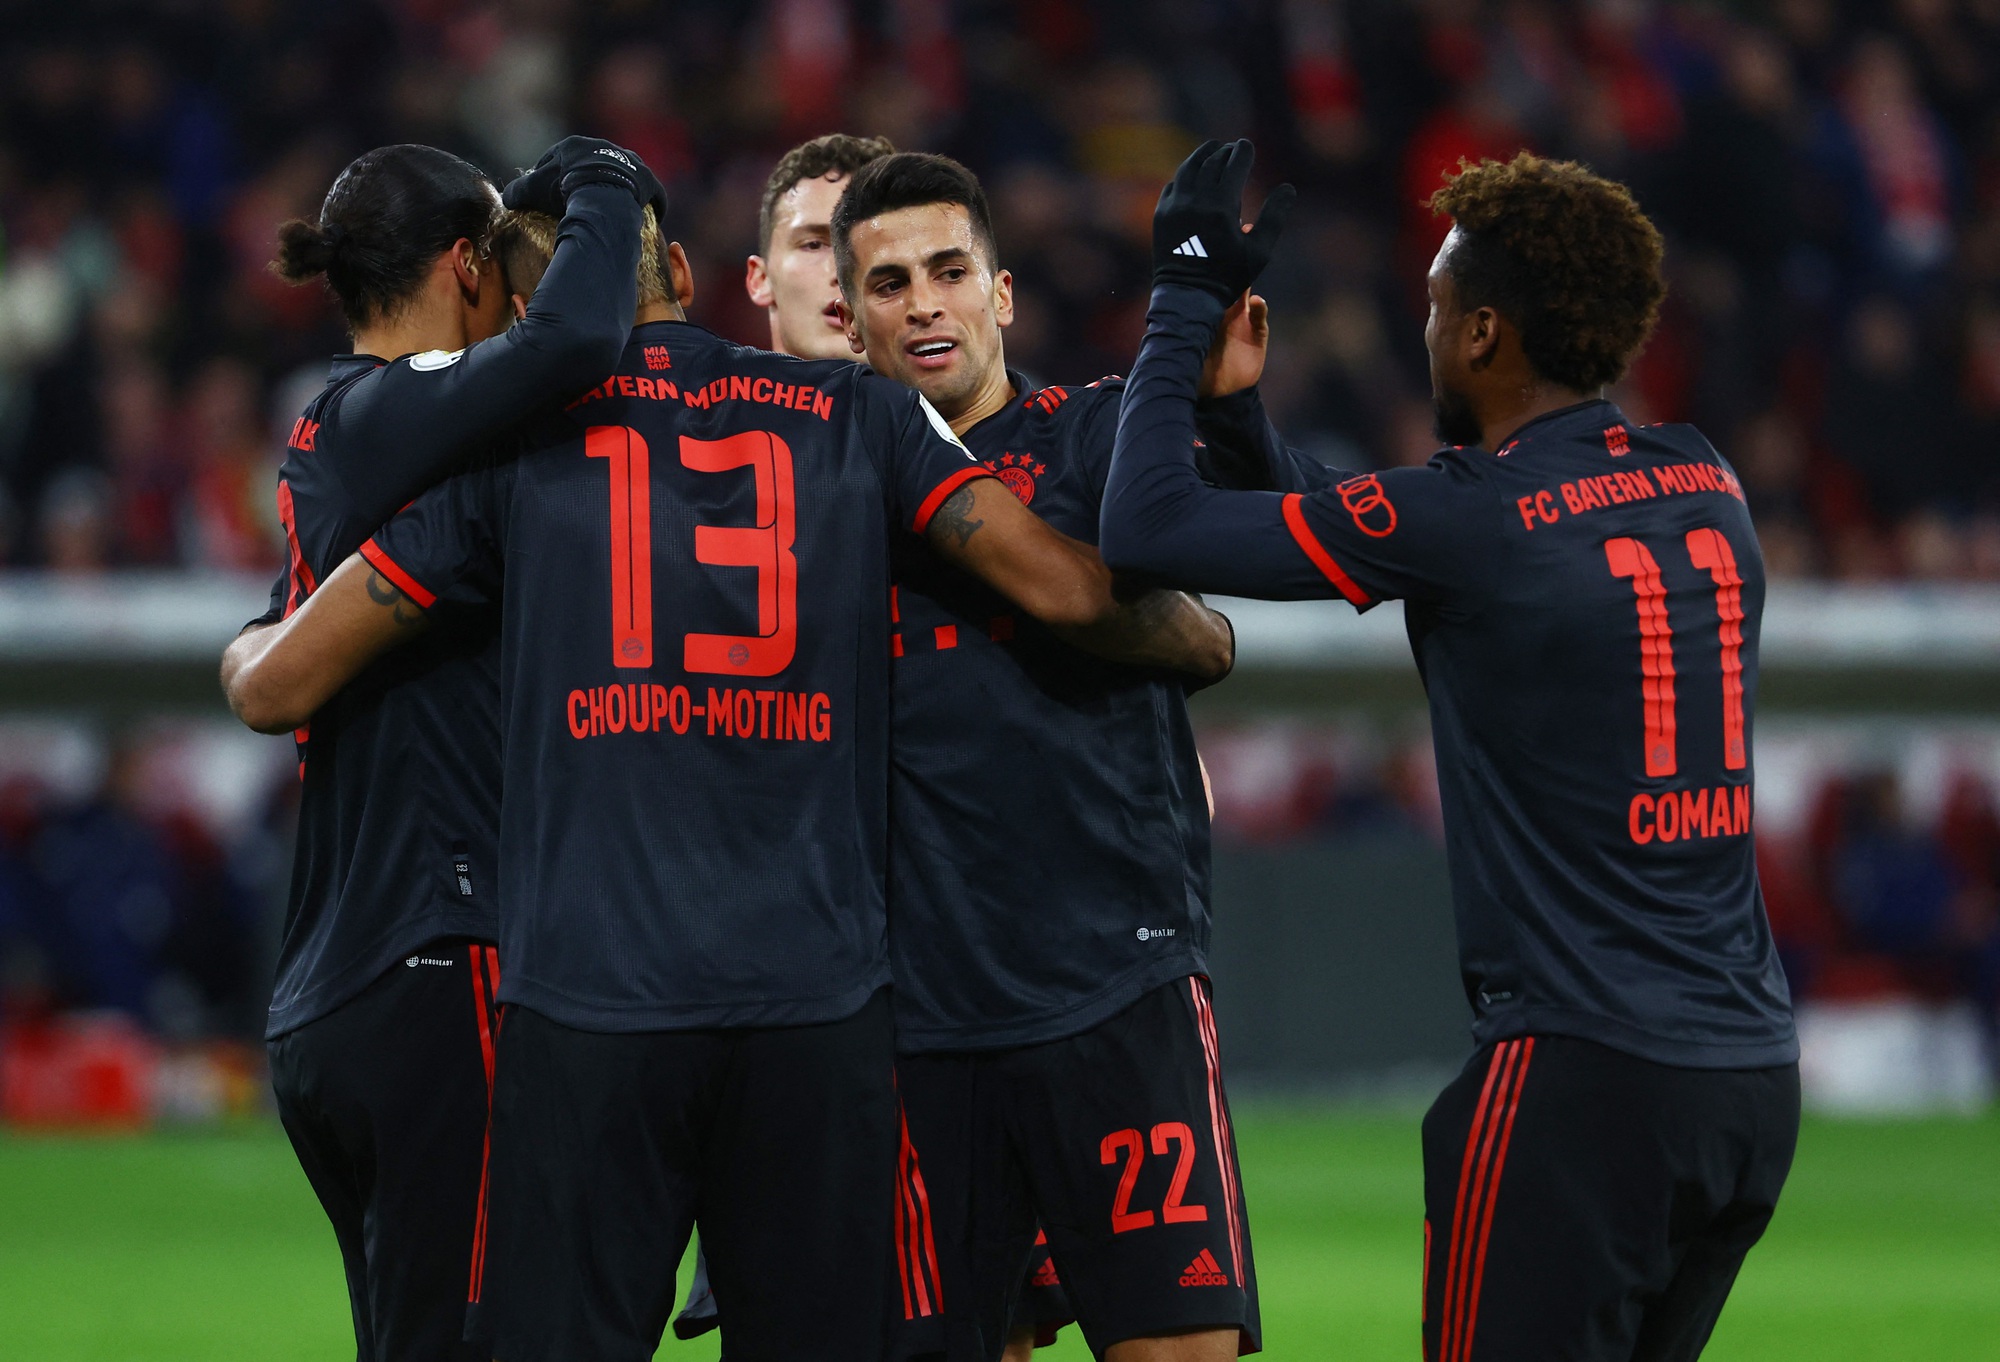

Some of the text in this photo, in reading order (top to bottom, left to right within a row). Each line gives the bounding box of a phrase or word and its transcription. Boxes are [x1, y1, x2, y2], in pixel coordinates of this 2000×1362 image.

[644, 346, 668, 356] MIA
[645, 355, 670, 364] SAN
[648, 362, 672, 370] MIA
[563, 375, 834, 421] YERN MÜNCHEN
[1603, 424, 1626, 438] MIA
[1610, 444, 1631, 457] MIA
[1517, 462, 1746, 531] FC BAYERN MÜNC
[585, 425, 797, 677] 13
[1604, 527, 1746, 777] 11
[567, 683, 832, 742] CHOUPO-MOTING
[1628, 784, 1750, 845] COMAN
[1100, 1121, 1208, 1235] 22
[1178, 1272, 1229, 1288] adidas
